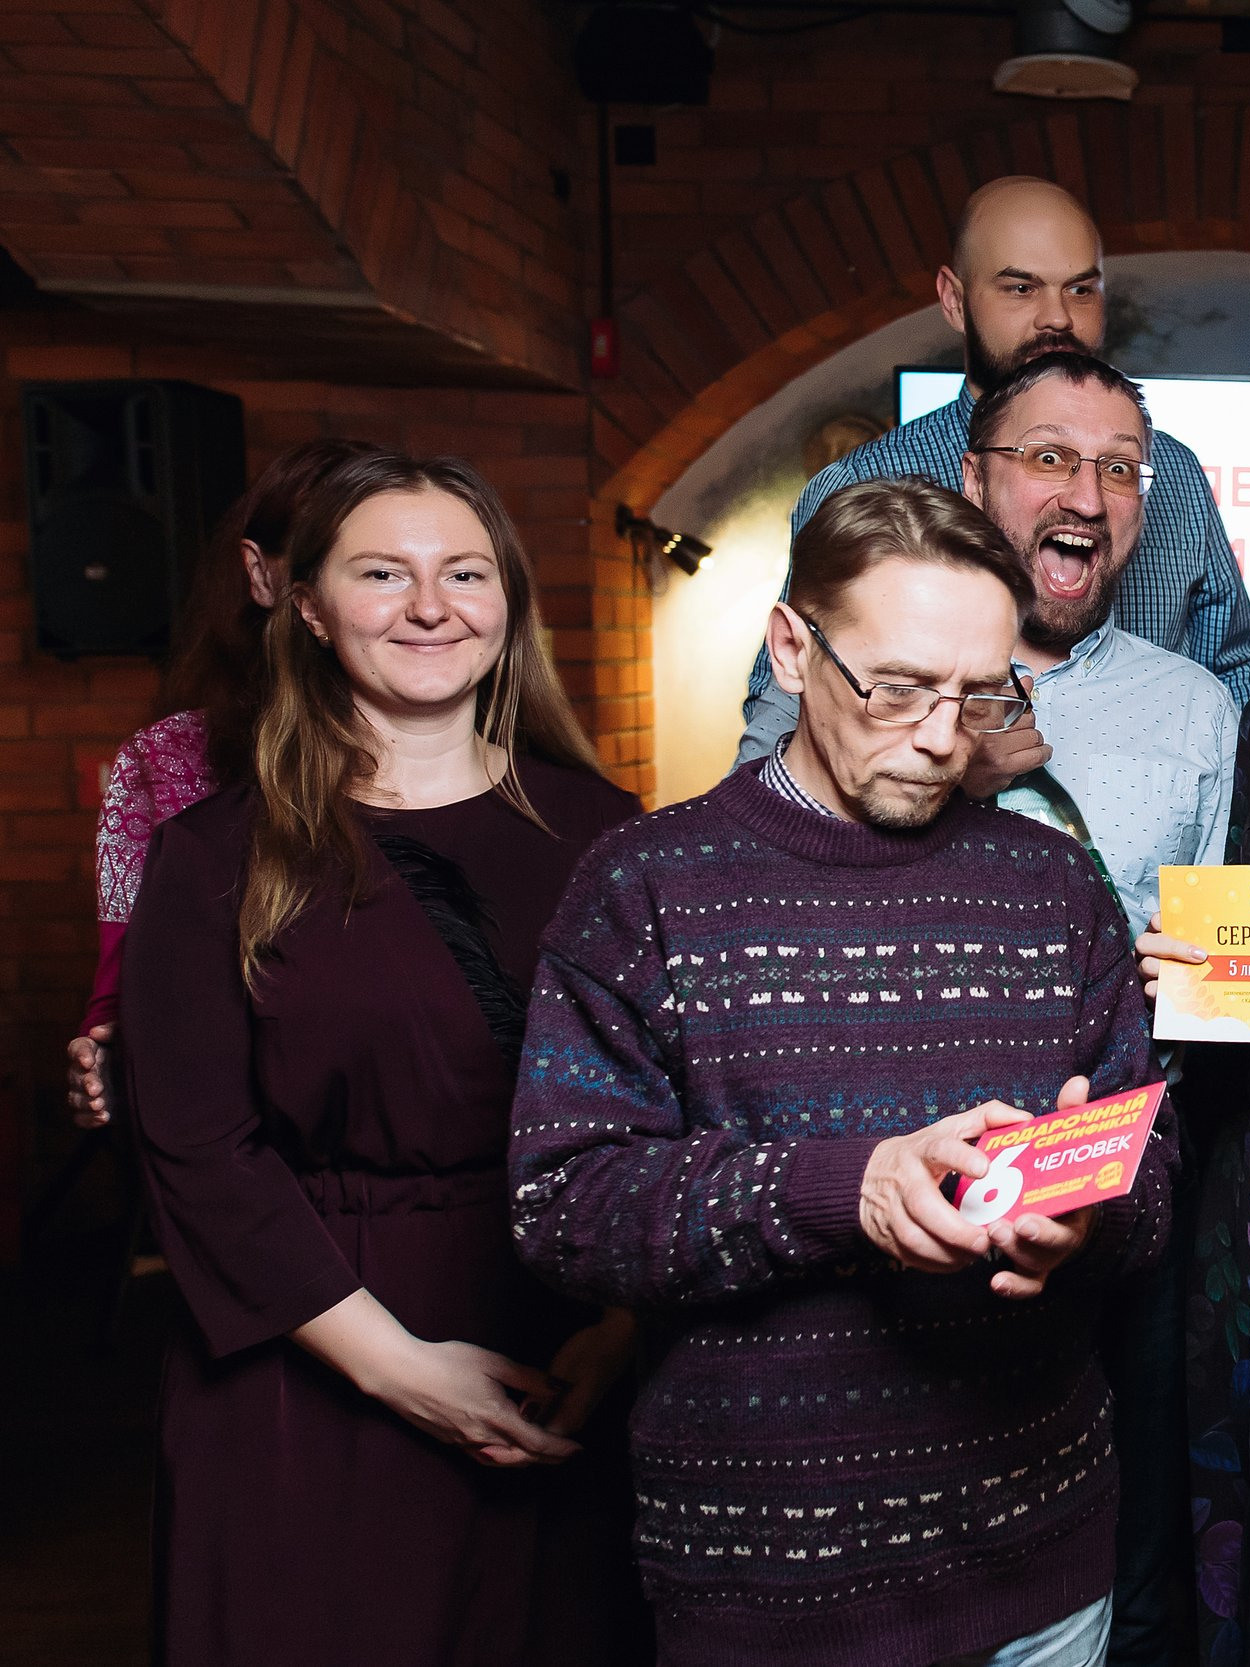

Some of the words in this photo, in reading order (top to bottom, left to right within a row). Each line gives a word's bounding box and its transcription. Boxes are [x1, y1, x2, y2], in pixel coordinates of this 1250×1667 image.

[1229, 960, 1237, 976] 5
[985, 1092, 1149, 1151] ПОДАРОЧНЫЙ
[1034, 1111, 1142, 1150] СЕРТИФИКАТ
[959, 1142, 1031, 1226] 6
[1034, 1133, 1134, 1172] ЧЕЛОВЕК
